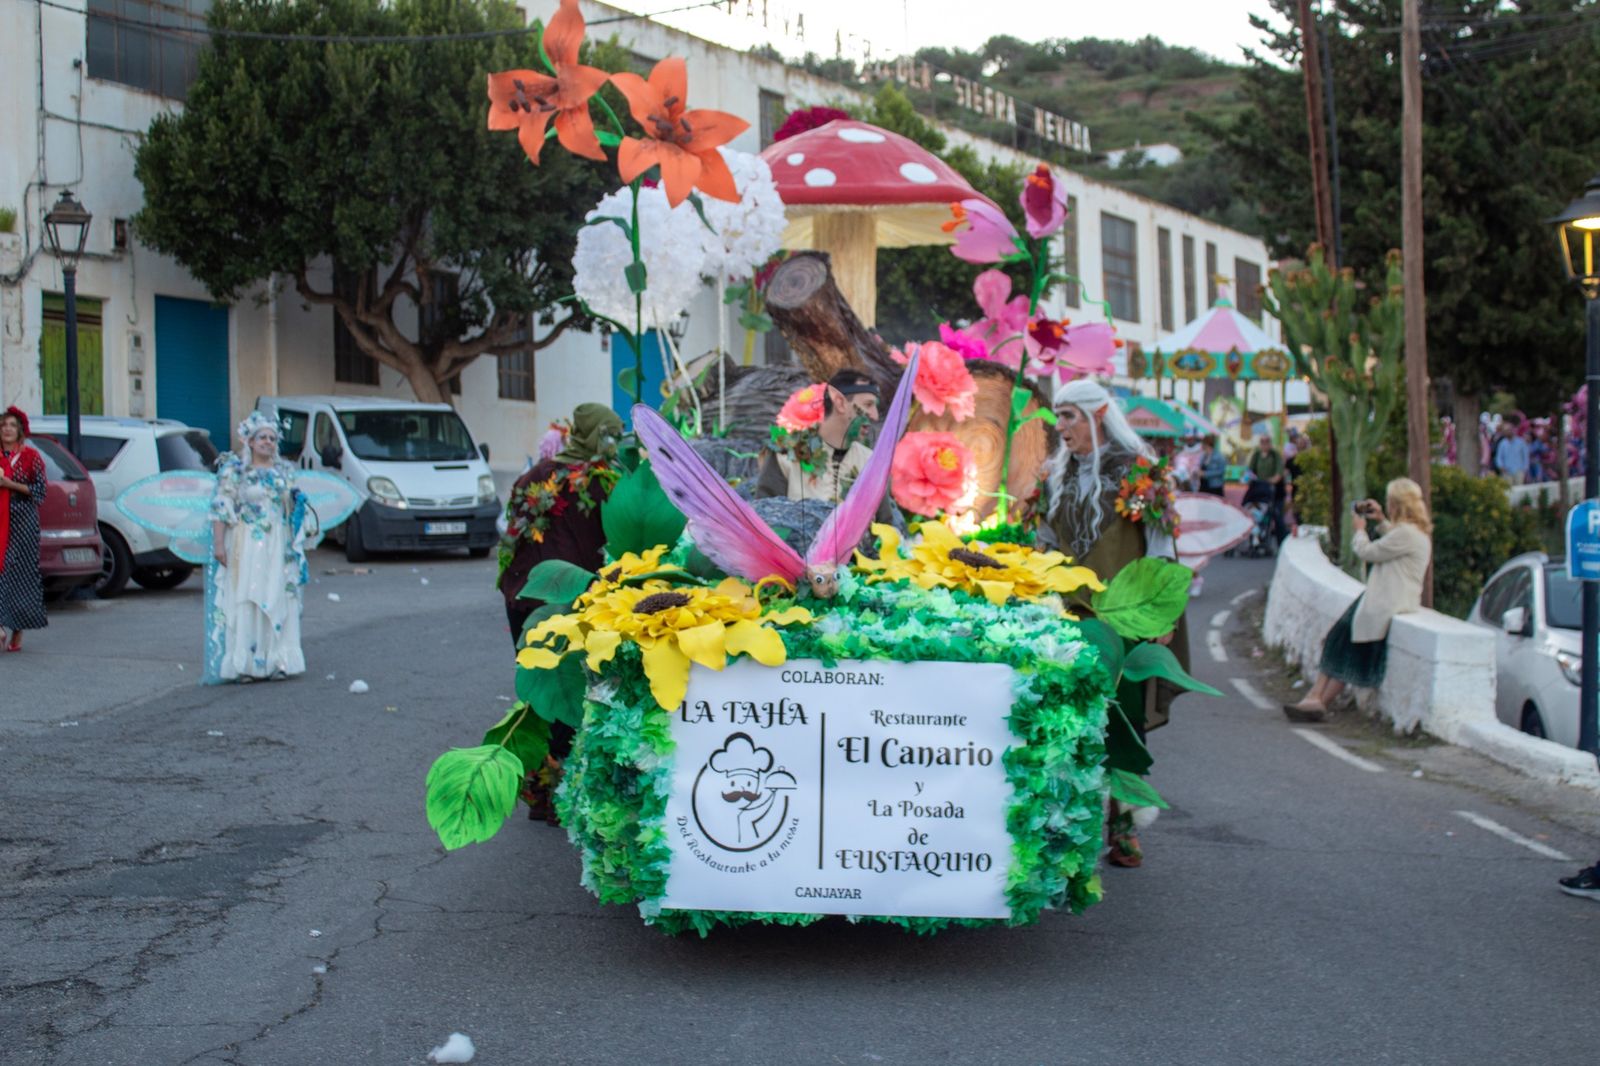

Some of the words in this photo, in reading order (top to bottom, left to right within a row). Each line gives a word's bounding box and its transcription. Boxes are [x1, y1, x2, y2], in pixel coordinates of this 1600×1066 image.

[1034, 106, 1091, 153] NEVADA
[781, 669, 884, 686] COLABORAN:
[680, 700, 715, 724] LA
[722, 697, 809, 729] TAHA
[870, 709, 968, 728] Restaurante
[837, 736, 870, 764] El
[880, 736, 994, 768] Canario
[914, 780, 925, 796] y
[867, 799, 893, 817] La
[897, 800, 965, 819] Posada
[676, 815, 690, 839] Del
[686, 838, 757, 874] Restaurante
[759, 859, 768, 869] a
[769, 850, 781, 862] tu
[779, 817, 800, 851] mesa
[907, 827, 929, 846] de
[835, 849, 993, 878] EUSTAQUIO
[795, 886, 863, 900] CANJAYAR
